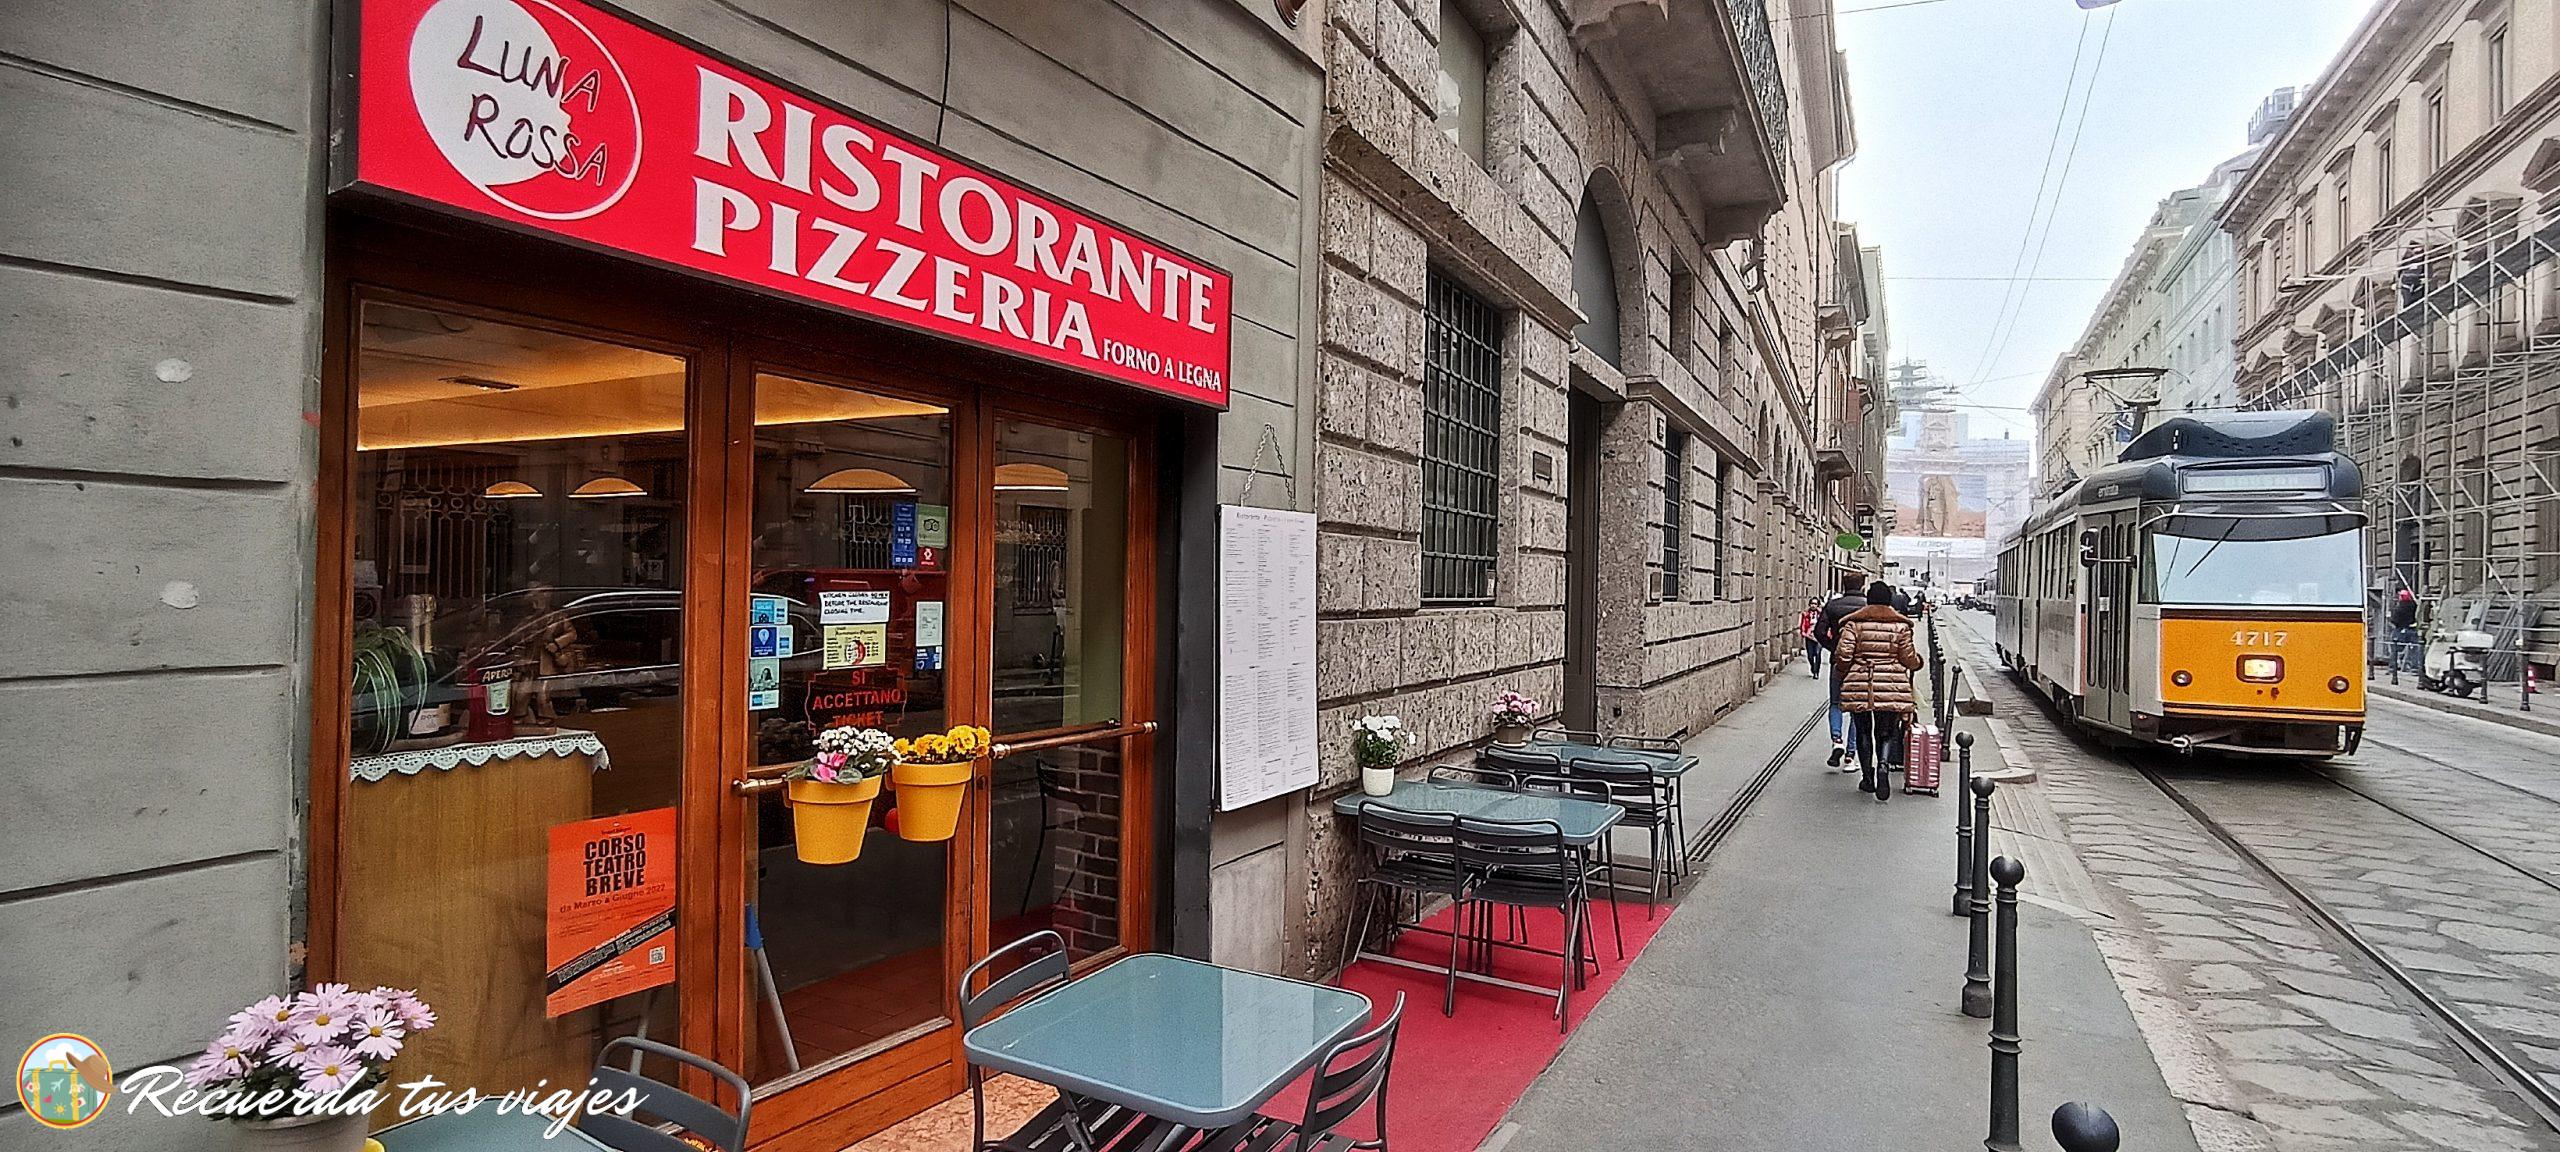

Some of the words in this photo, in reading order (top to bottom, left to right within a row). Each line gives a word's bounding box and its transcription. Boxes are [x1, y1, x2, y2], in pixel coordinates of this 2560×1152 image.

[457, 15, 601, 112] LUNA
[464, 93, 607, 186] ROSSA
[693, 64, 1217, 335] RISTORANTE
[692, 176, 1101, 360] PIZZERIA
[1103, 337, 1161, 375] FORNO
[1163, 357, 1175, 380] A
[1178, 360, 1223, 393] LEGNA
[2230, 630, 2289, 647] 4717
[852, 671, 866, 685] SI
[812, 689, 901, 711] ACCETTANO
[832, 710, 884, 728] TICKET
[585, 832, 646, 860] CORSO
[583, 850, 646, 879] TEATRO
[586, 868, 645, 898] BREVE
[612, 889, 645, 902] Giugno
